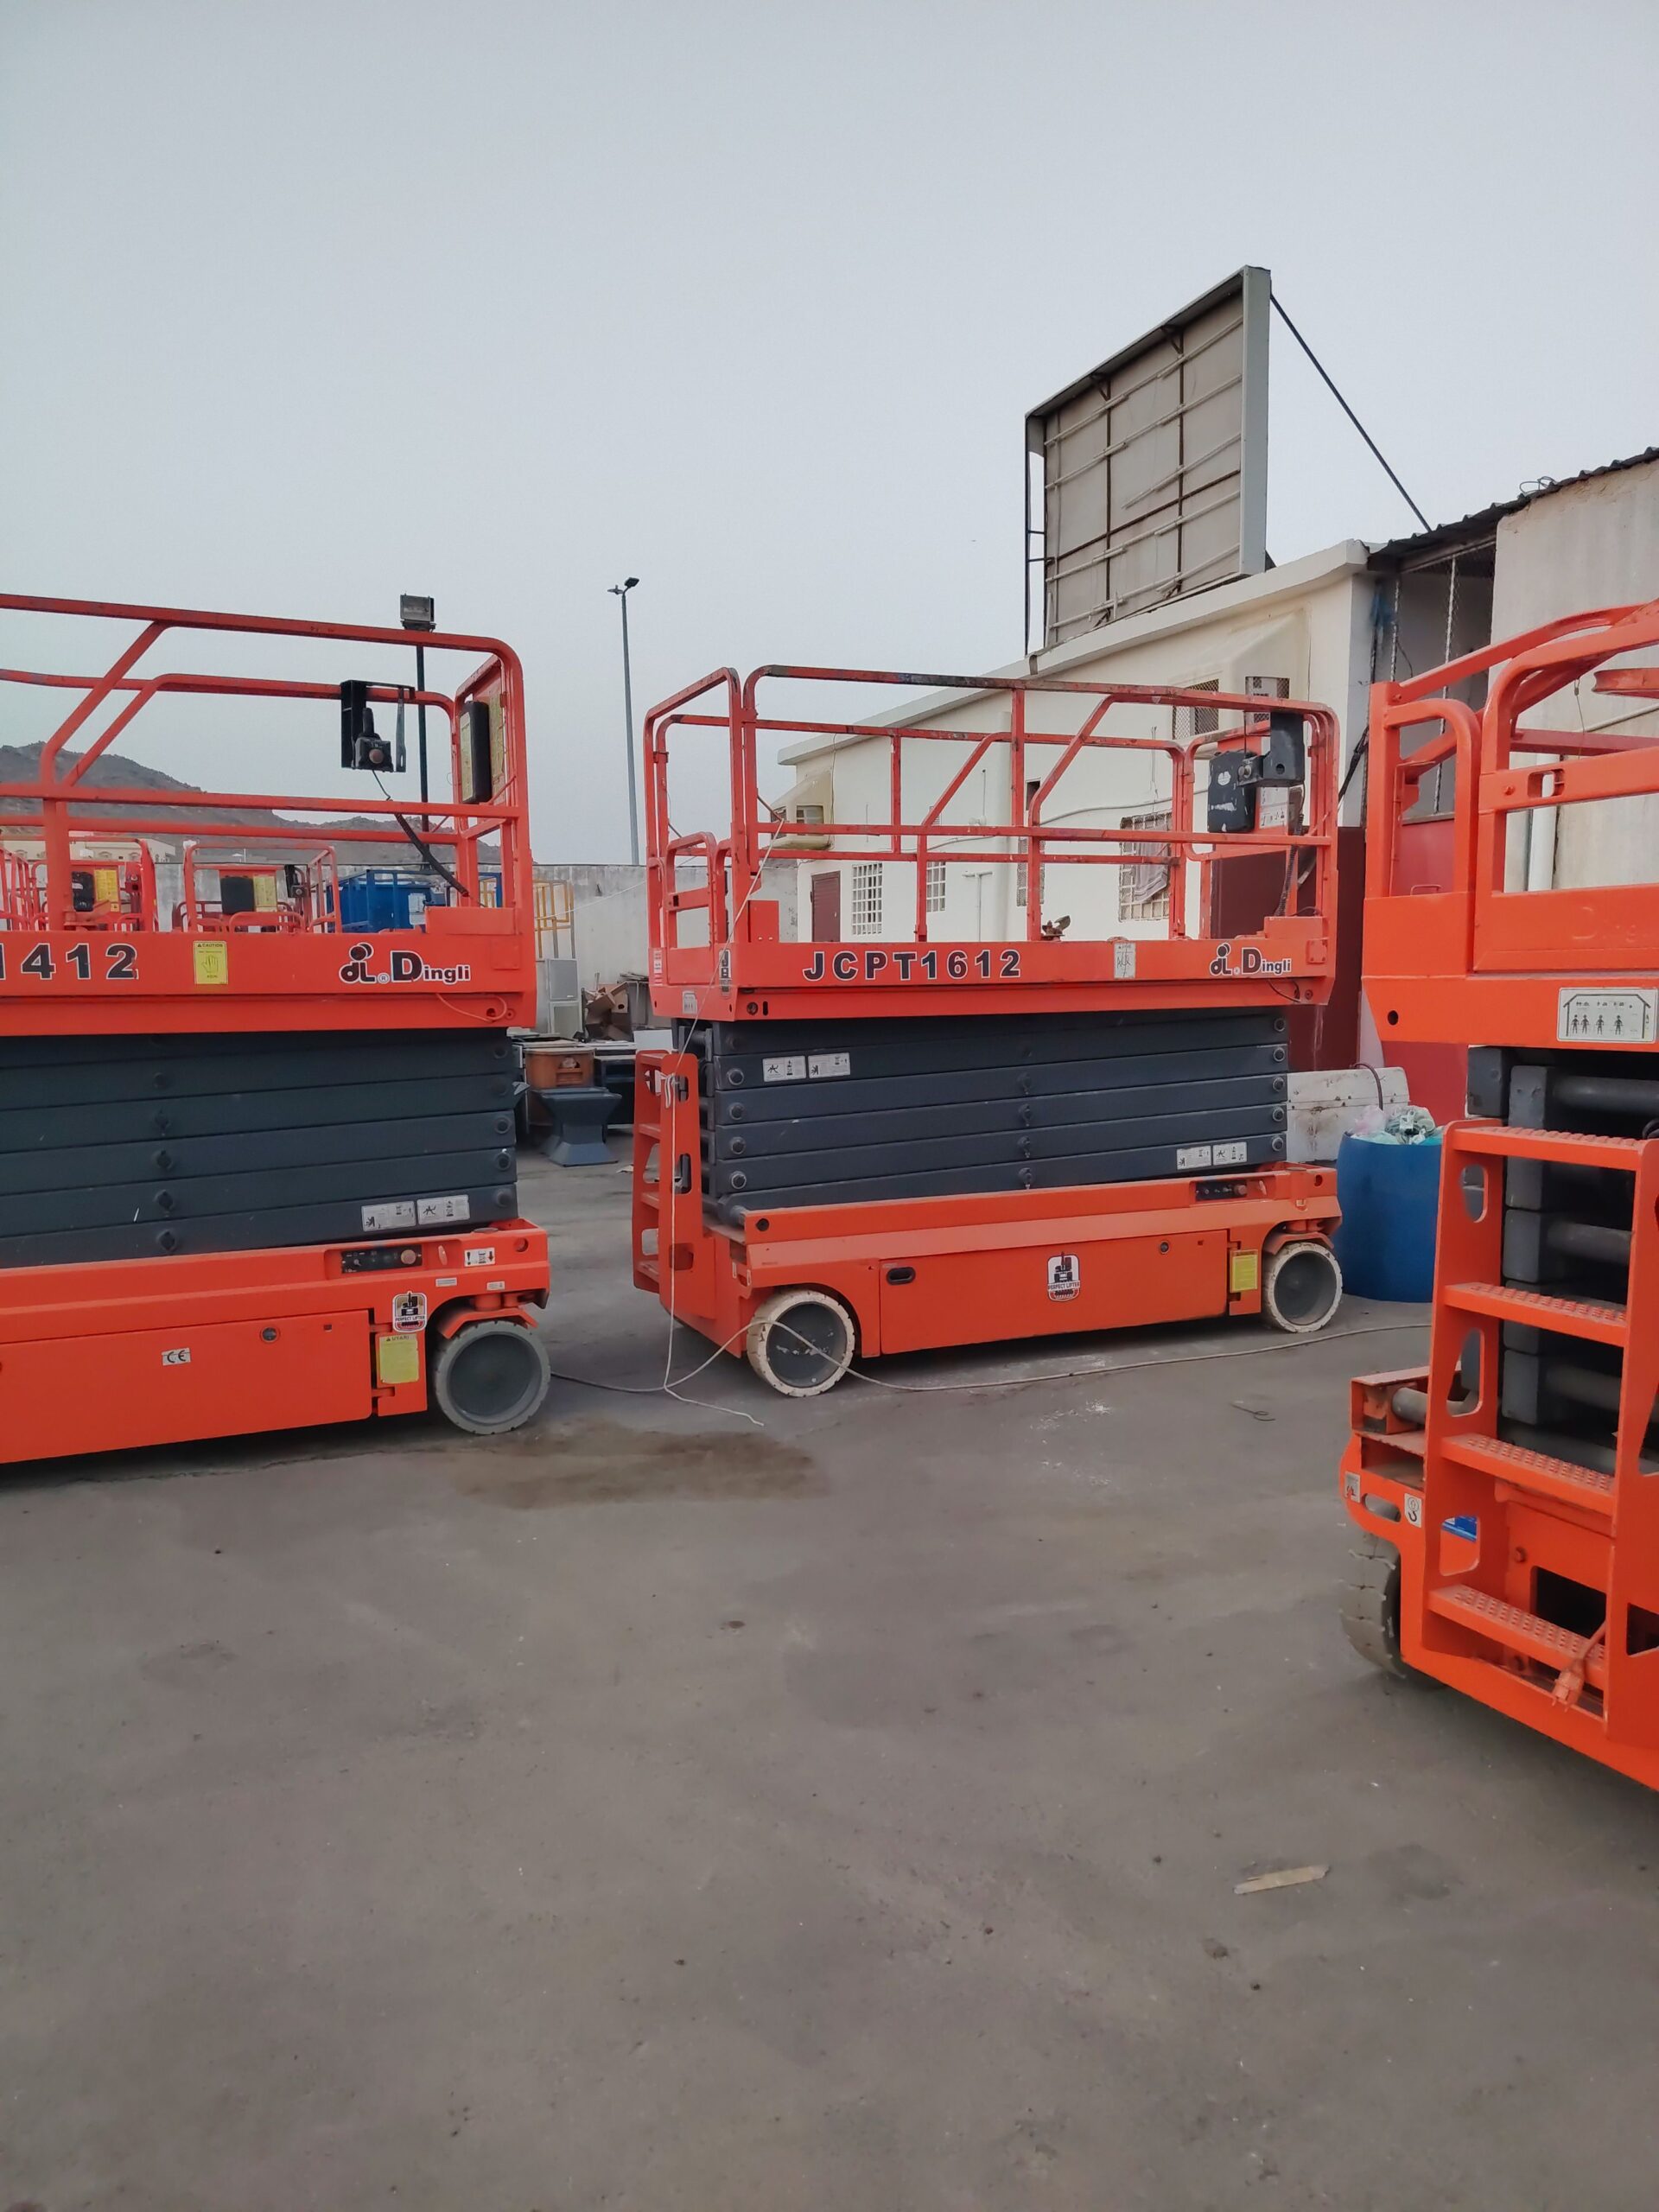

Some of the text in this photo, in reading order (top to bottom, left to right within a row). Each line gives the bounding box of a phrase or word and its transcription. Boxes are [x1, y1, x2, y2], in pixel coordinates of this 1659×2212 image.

[0, 943, 139, 980] 412
[391, 950, 470, 984] Dingli
[802, 950, 1020, 982] JCPT1612
[1242, 948, 1291, 976] Dingli
[167, 1350, 186, 1363] CE
